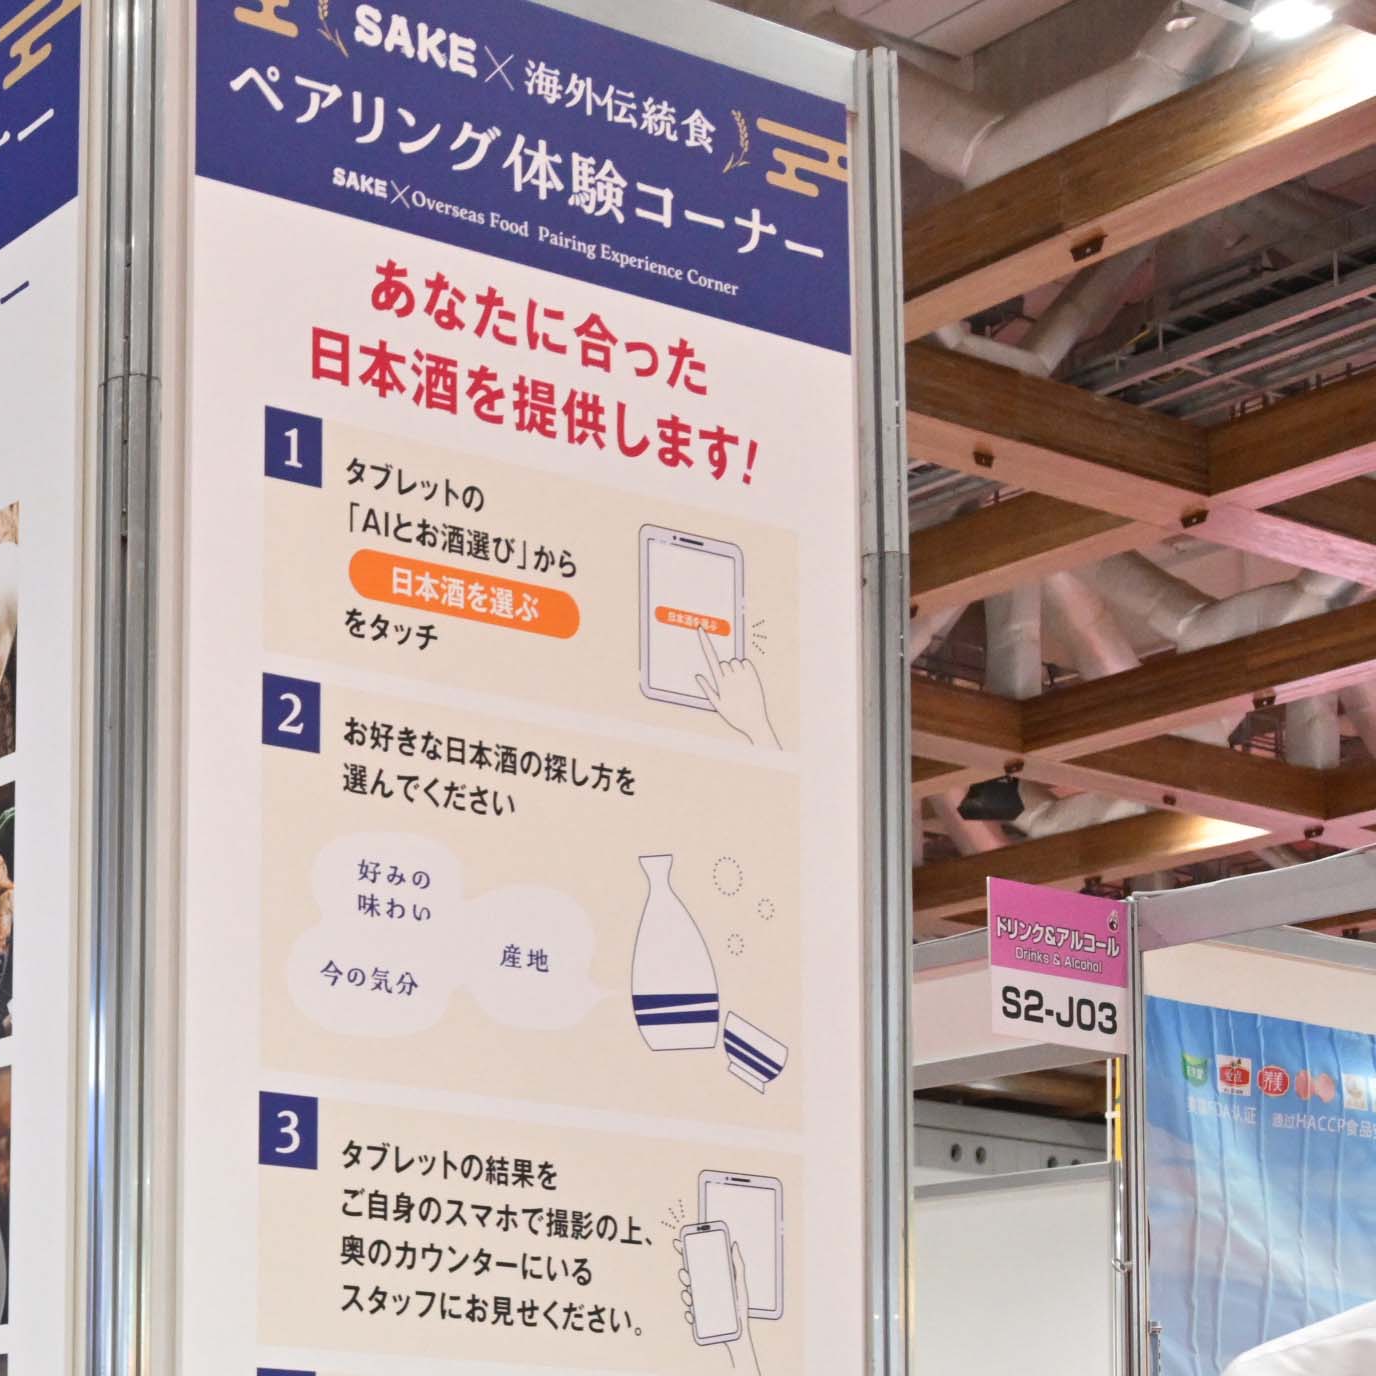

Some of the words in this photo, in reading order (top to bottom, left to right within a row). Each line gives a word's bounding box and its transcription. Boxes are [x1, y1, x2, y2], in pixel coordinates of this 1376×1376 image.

[229, 64, 825, 260] ペアリング体験コーナー
[490, 212, 528, 238] Food
[538, 225, 596, 261] Pairing
[601, 244, 683, 281] Experience
[687, 269, 739, 296] Corner
[371, 258, 708, 397] あなたに合った
[283, 427, 303, 468] 1
[346, 457, 484, 513] タブレットの
[349, 502, 577, 579] 「AIとお酒選び」から
[392, 565, 539, 623] 日本酒を選ぶ
[345, 607, 438, 652] をタッチ
[279, 692, 304, 736] 2
[343, 717, 636, 797] お好きな日本酒の探し方を
[343, 761, 516, 817] 選んでください
[358, 858, 431, 890] 好みの
[358, 893, 432, 923] 味わい
[320, 960, 419, 996] 今の気分
[500, 943, 550, 973] 産地
[1015, 946, 1049, 964] Drinks
[1053, 954, 1061, 965] &
[1064, 956, 1103, 973] Alcohol
[1002, 985, 1118, 1036] S2-J03
[275, 1110, 302, 1154] 3
[342, 1139, 558, 1192] タブレットの結果を
[342, 1188, 653, 1247] ご自身のスマホで撮影の上、
[340, 1235, 593, 1287] 奥のカウンターにいる
[341, 1284, 643, 1337] スタッフにお見せください。
